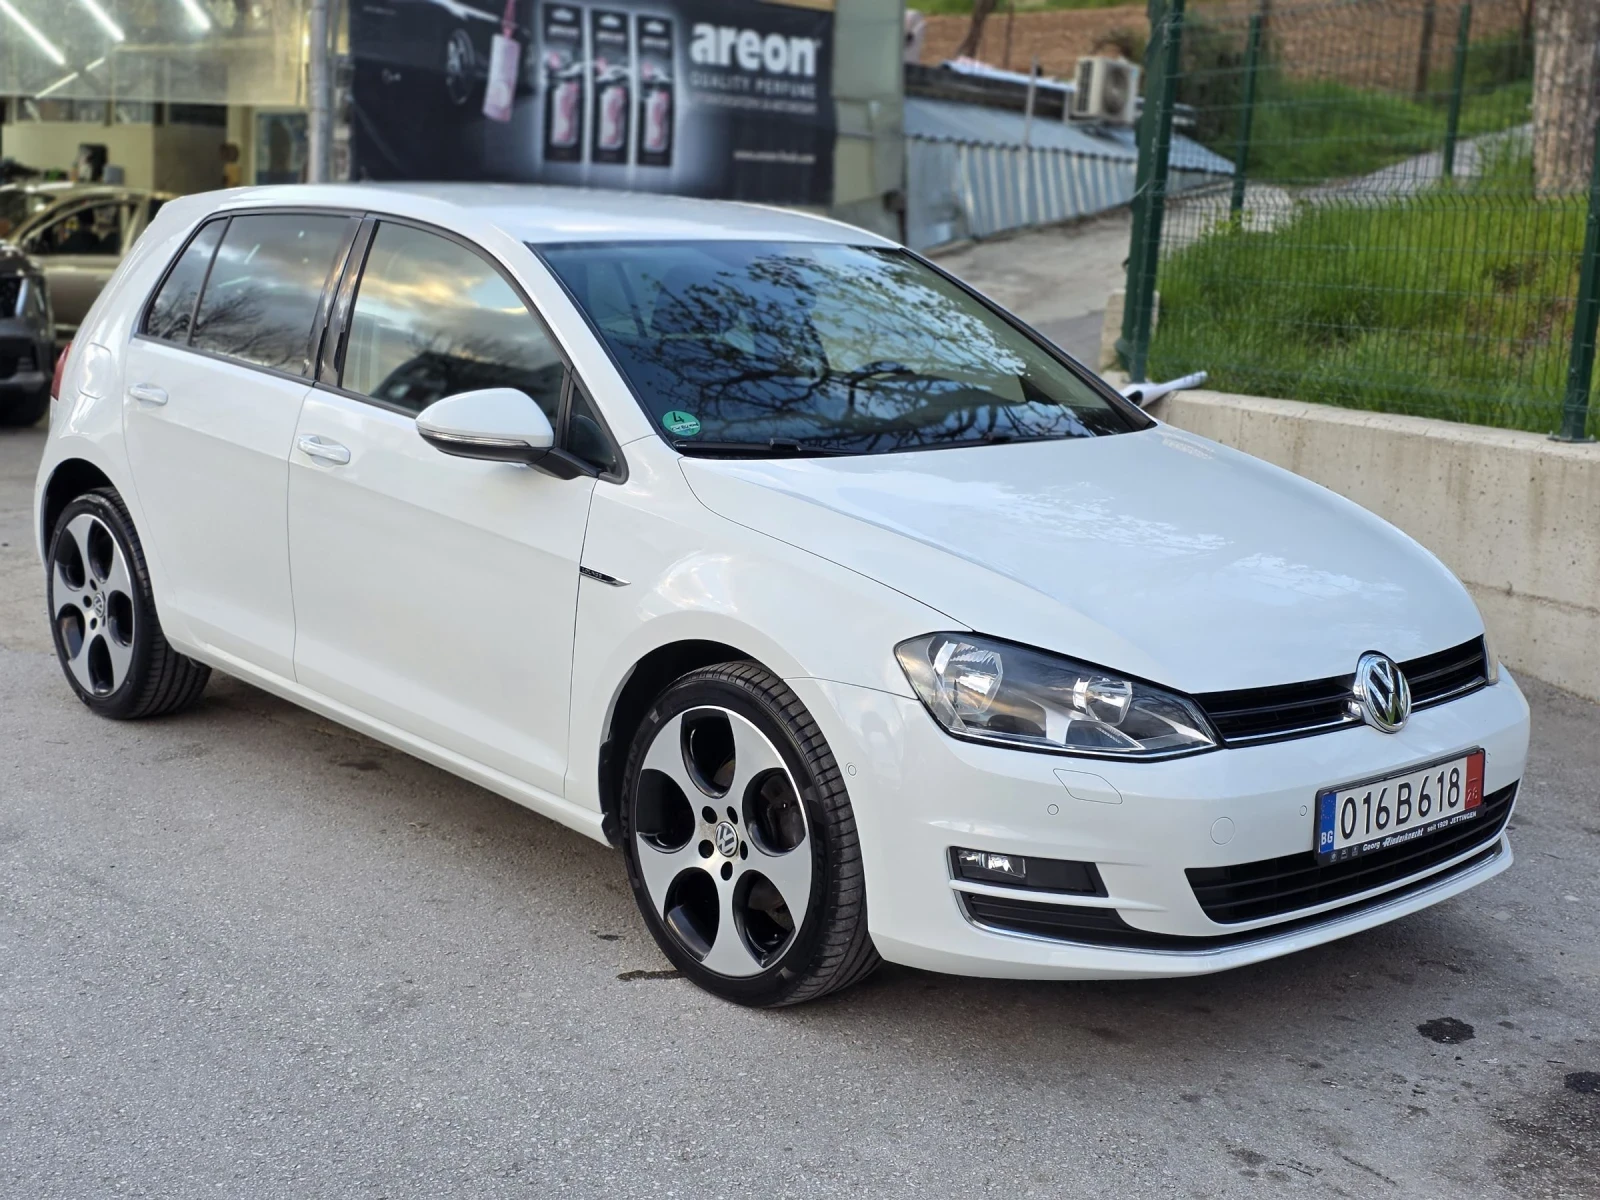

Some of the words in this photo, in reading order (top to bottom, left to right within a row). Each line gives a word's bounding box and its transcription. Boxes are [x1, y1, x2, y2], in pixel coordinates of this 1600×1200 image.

[690, 23, 816, 76] areon
[1320, 830, 1334, 846] BG
[1340, 767, 1460, 840] 016B618
[1362, 841, 1381, 852] Georg
[1427, 824, 1437, 833] seit
[1449, 810, 1477, 826] JETTINGEN
